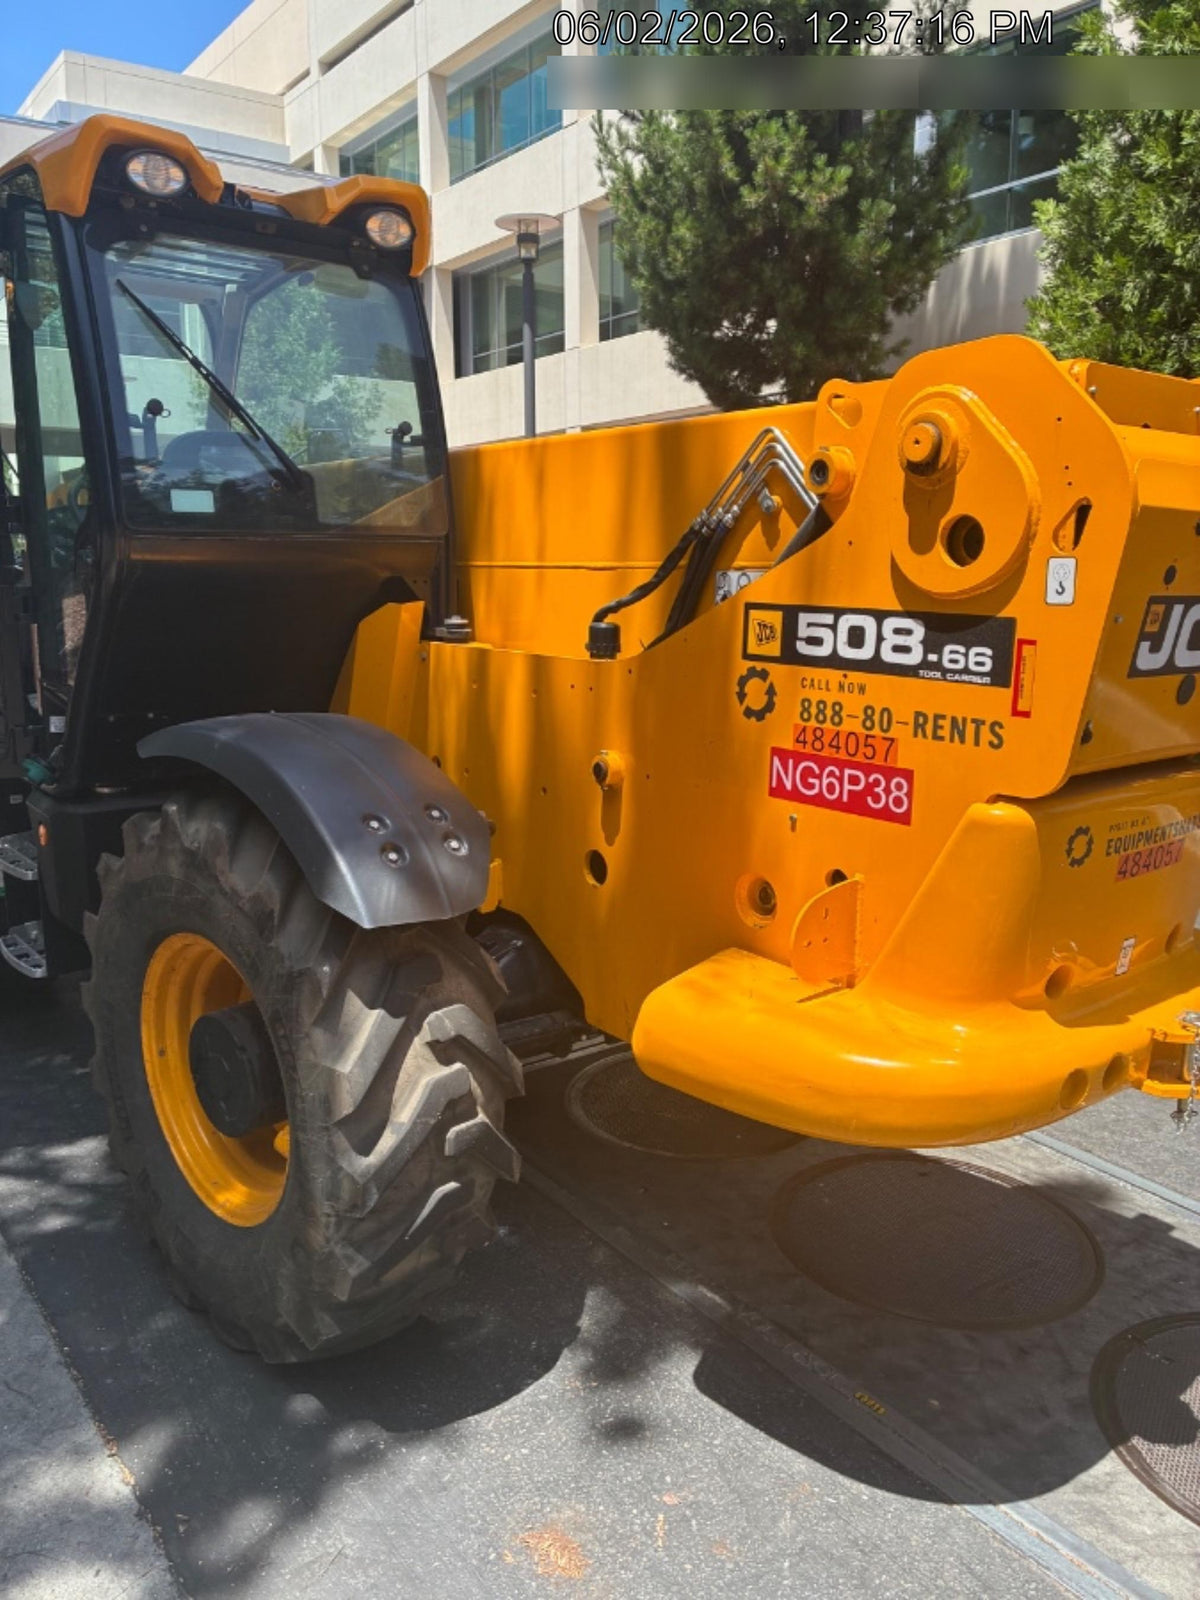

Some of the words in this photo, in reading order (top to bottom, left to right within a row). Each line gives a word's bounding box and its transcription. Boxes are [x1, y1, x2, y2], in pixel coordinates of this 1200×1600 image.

[801, 676, 831, 692] CALL
[838, 680, 867, 696] NOW
[918, 669, 944, 680] TOOL
[945, 672, 991, 684] CARRIER
[799, 697, 1005, 750] 888-80-RENTS
[795, 726, 896, 763] 484057
[771, 755, 909, 814] NG6P38
[1117, 839, 1186, 879] 484057
